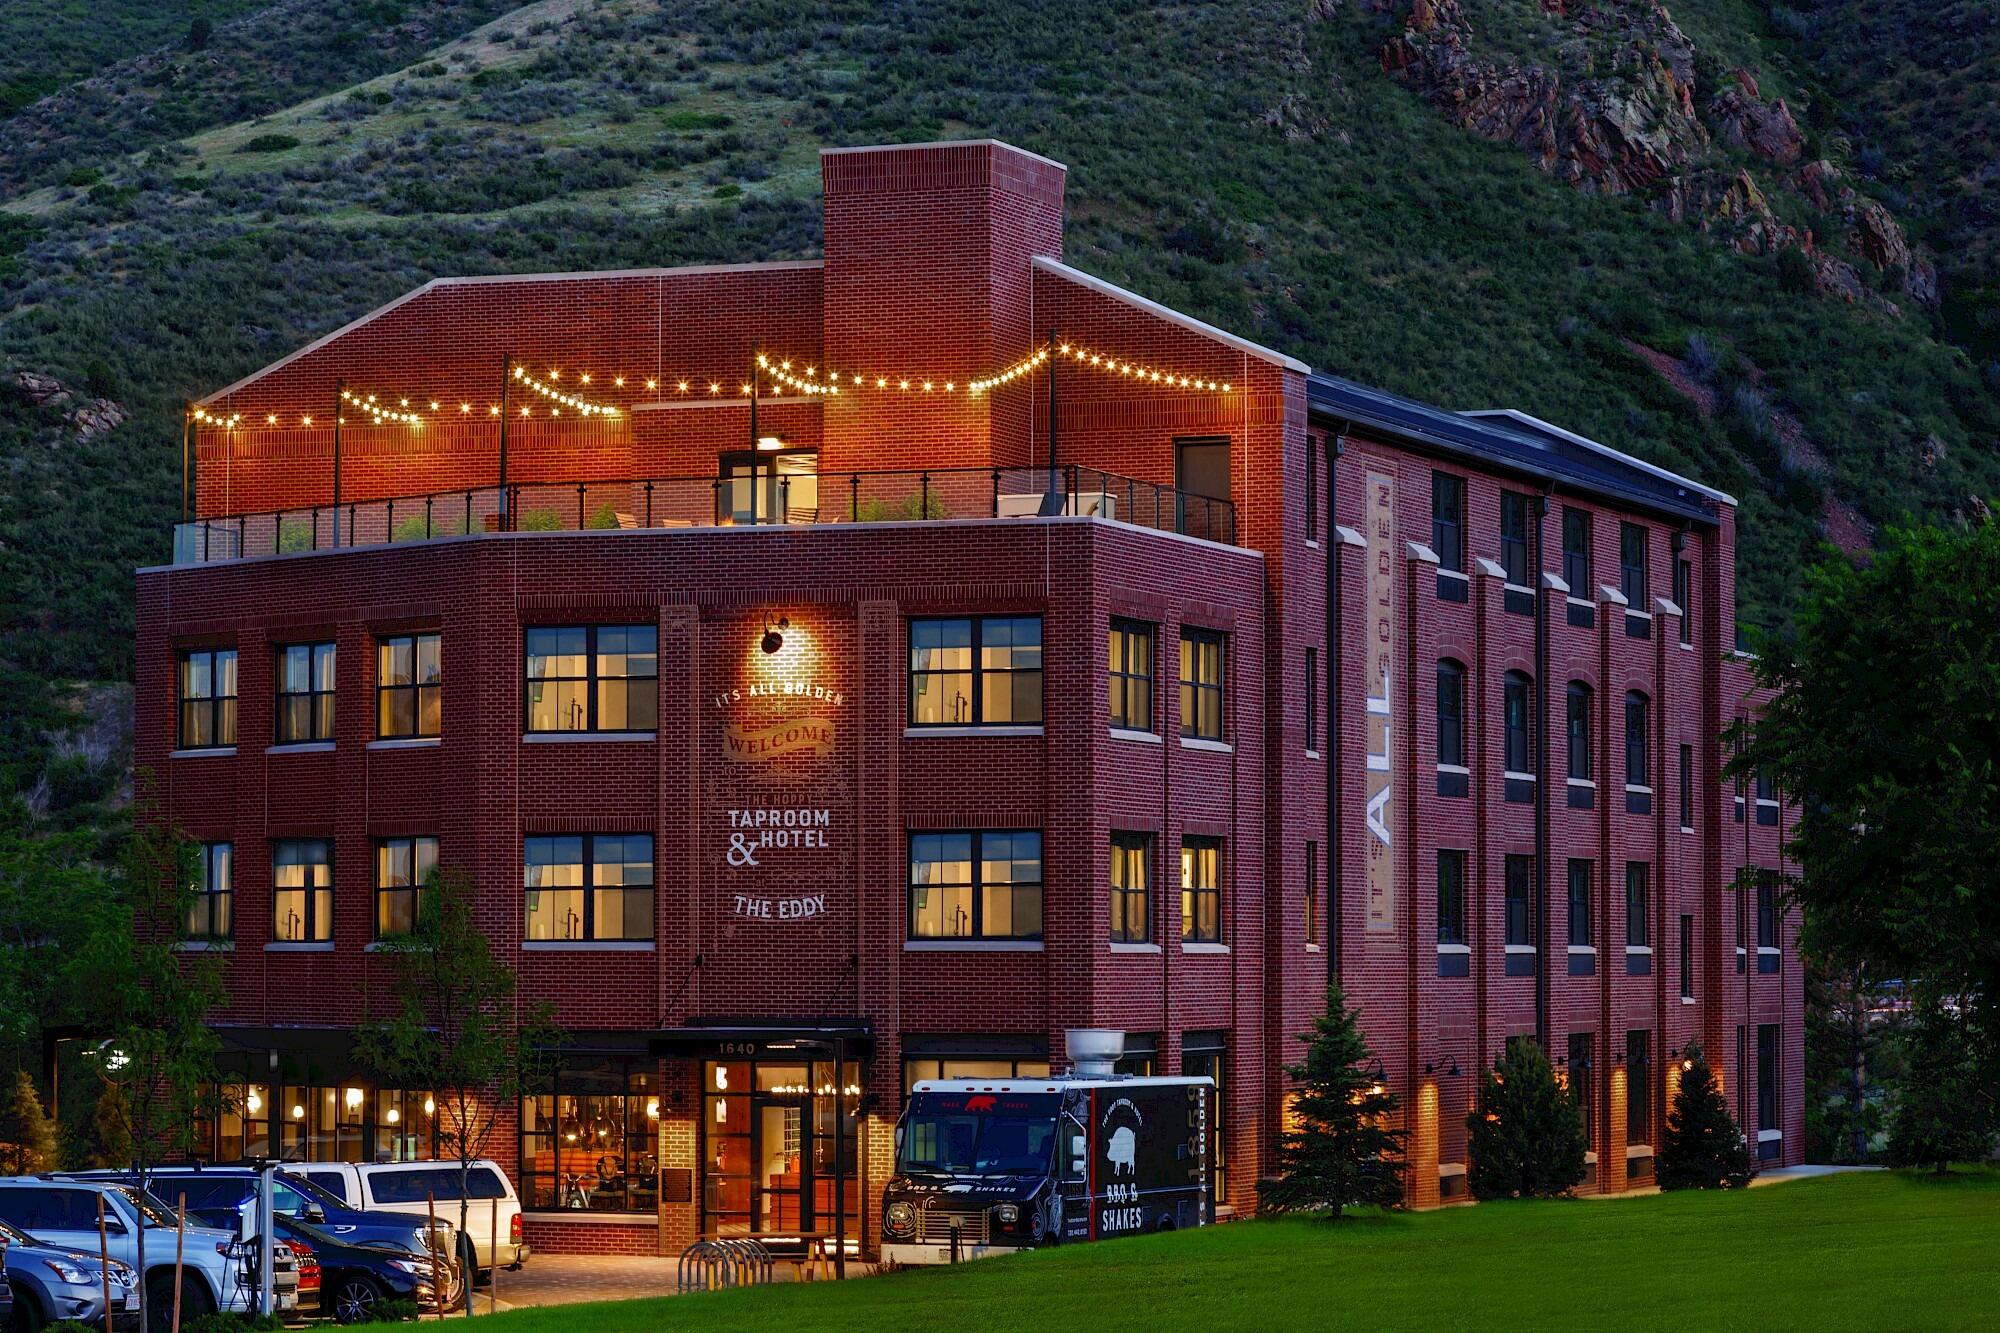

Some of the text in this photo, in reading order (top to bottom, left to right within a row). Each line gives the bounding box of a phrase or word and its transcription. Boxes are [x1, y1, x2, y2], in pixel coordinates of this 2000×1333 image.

[1378, 484, 1390, 677] GOLDEN
[749, 682, 776, 697] ALL
[784, 682, 844, 706] GOLDEN
[727, 726, 832, 754] WELCOME
[1366, 668, 1391, 848] ALL
[745, 793, 813, 805] THE HOPPY
[728, 809, 829, 827] TAPROOM
[726, 830, 829, 866] & HOTEL
[735, 894, 825, 919] THE EDDY
[720, 1043, 755, 1055] 1640
[1106, 1184, 1128, 1204] BBQ
[1102, 1207, 1142, 1232] SHAKES
